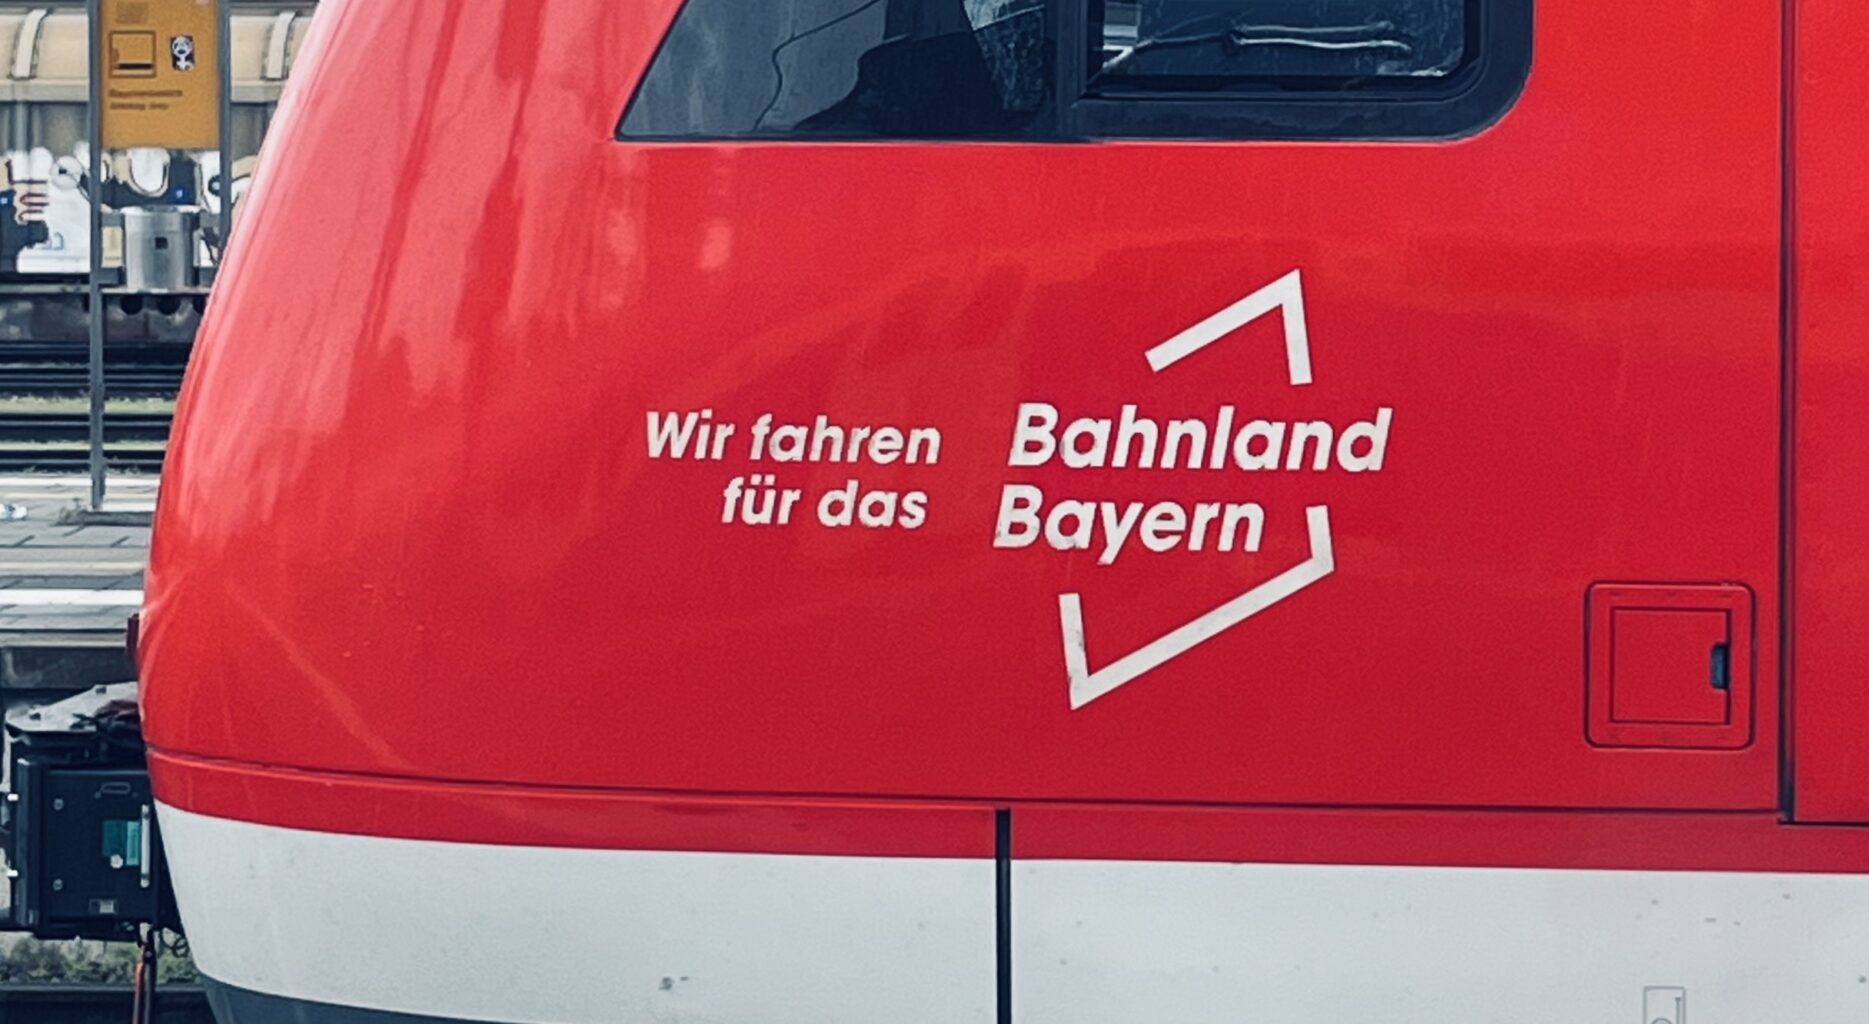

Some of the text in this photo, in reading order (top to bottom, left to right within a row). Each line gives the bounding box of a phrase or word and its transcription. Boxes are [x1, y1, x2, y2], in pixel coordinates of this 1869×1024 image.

[647, 408, 941, 465] Wir fahren
[1008, 402, 1393, 472] Bahnland
[722, 474, 928, 529] für das
[993, 484, 1265, 565] Bayern
